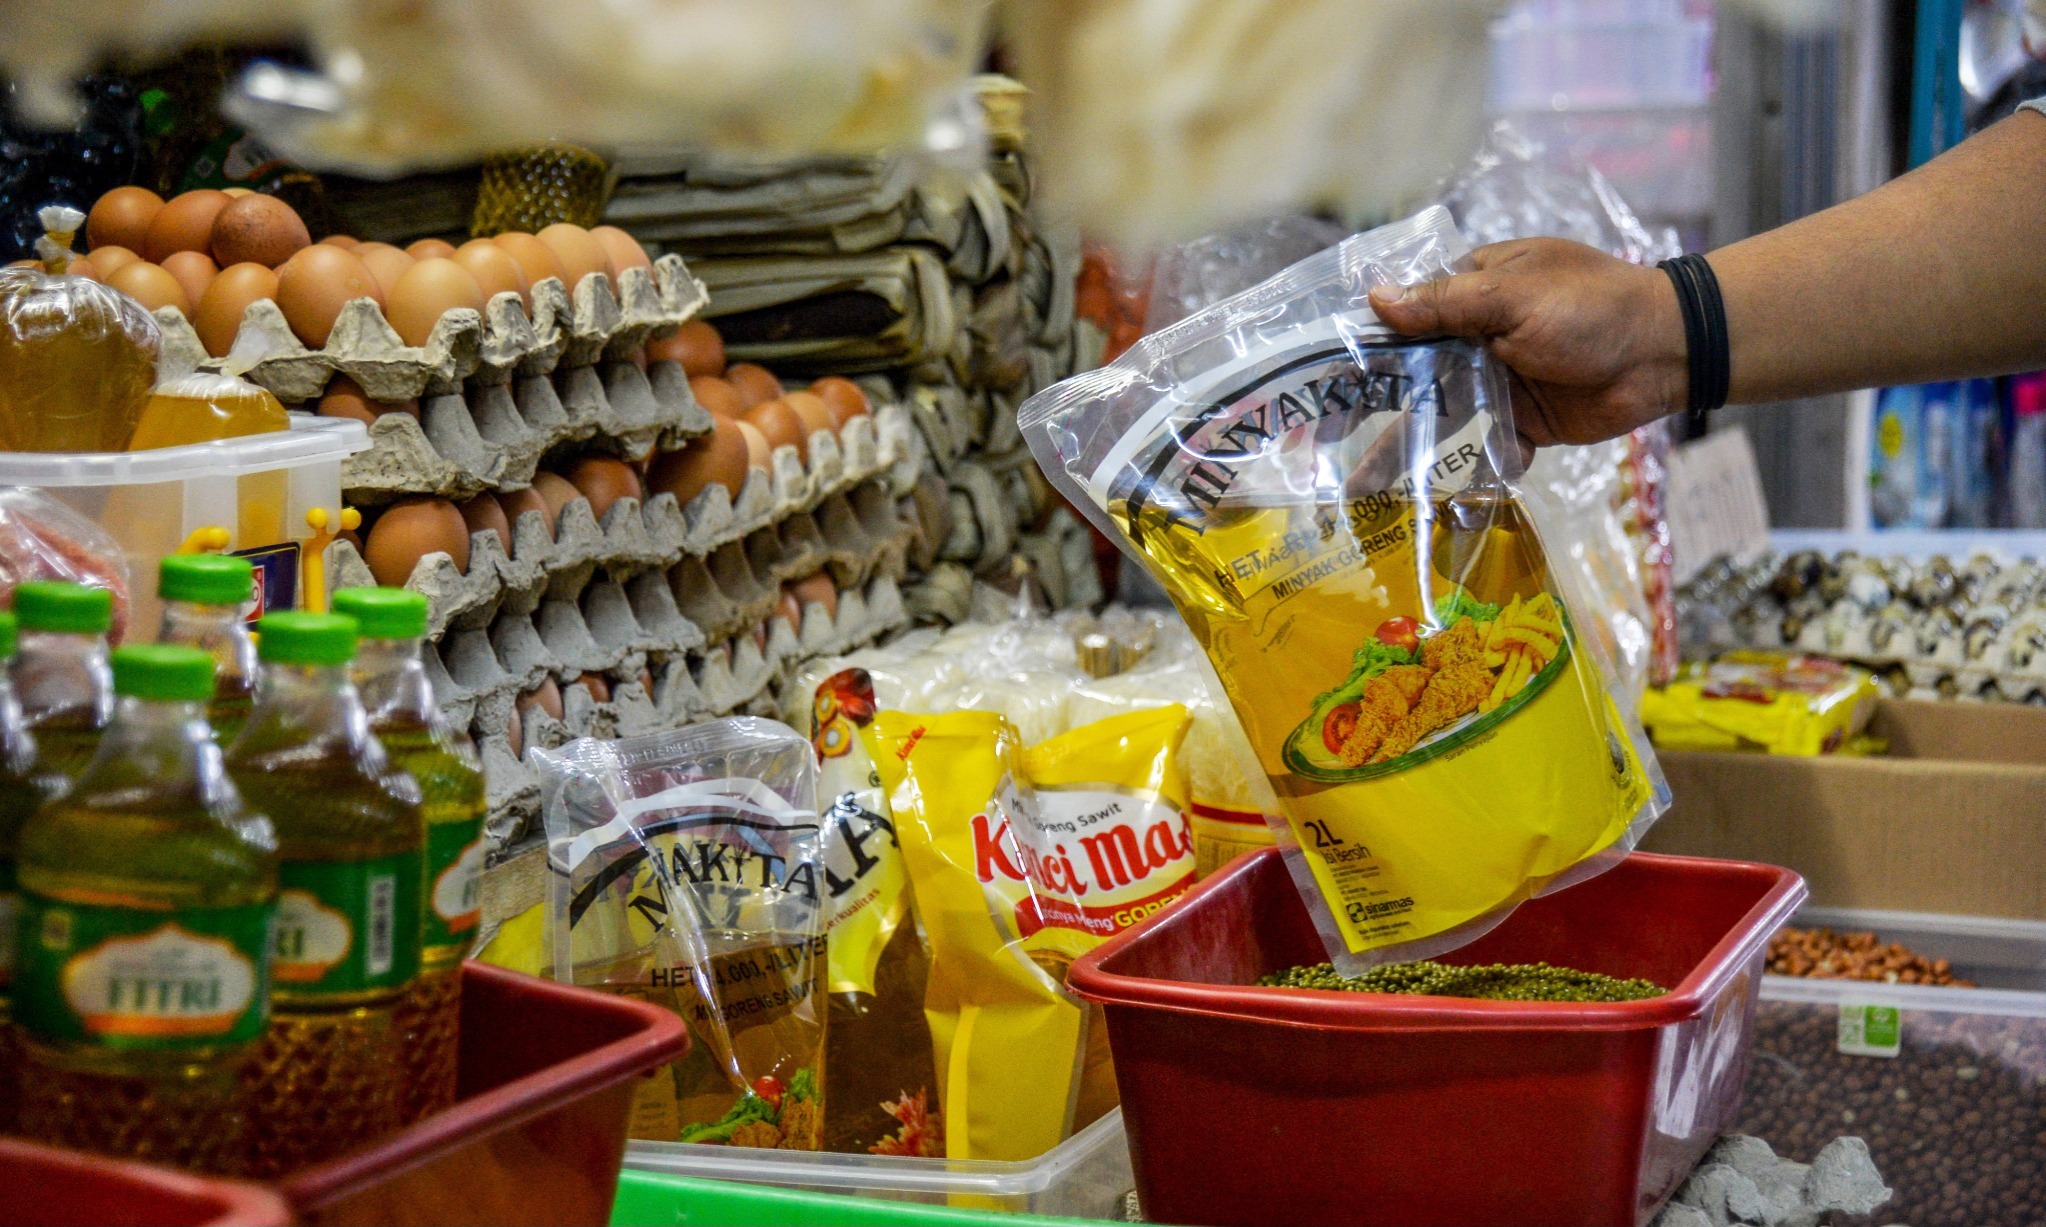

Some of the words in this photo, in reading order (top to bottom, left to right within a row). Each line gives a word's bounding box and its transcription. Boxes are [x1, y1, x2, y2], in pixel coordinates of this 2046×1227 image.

[1271, 555, 1338, 600] MINYAK
[1077, 802, 1122, 827] Sawit
[1303, 818, 1344, 849] 2L
[1333, 842, 1372, 863] Bersih
[1364, 896, 1415, 915] sinarmas
[651, 964, 695, 989] HET
